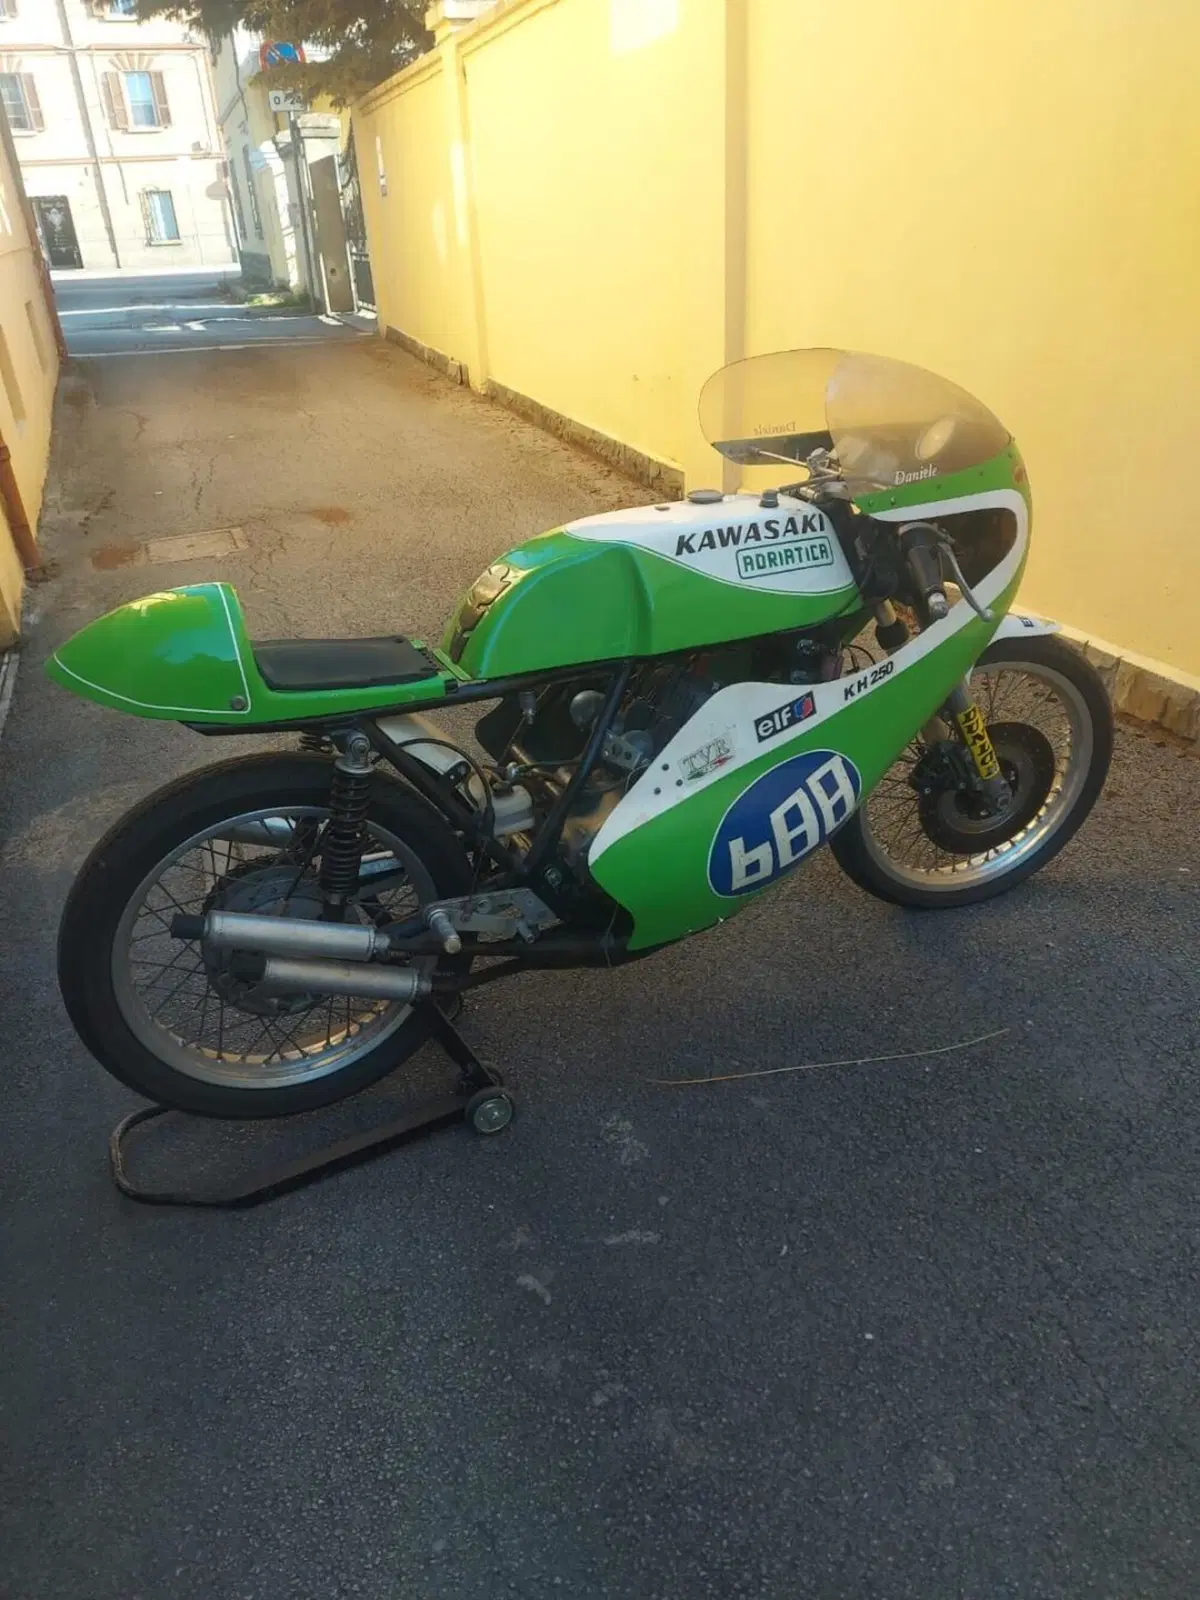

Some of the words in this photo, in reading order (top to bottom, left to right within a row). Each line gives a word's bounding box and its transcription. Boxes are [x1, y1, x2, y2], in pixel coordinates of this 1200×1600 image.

[894, 463, 938, 486] Daniele
[675, 513, 826, 556] KAWASAKI
[742, 542, 830, 573] ADRIATICA
[870, 660, 895, 685] 250
[757, 705, 794, 738] elf
